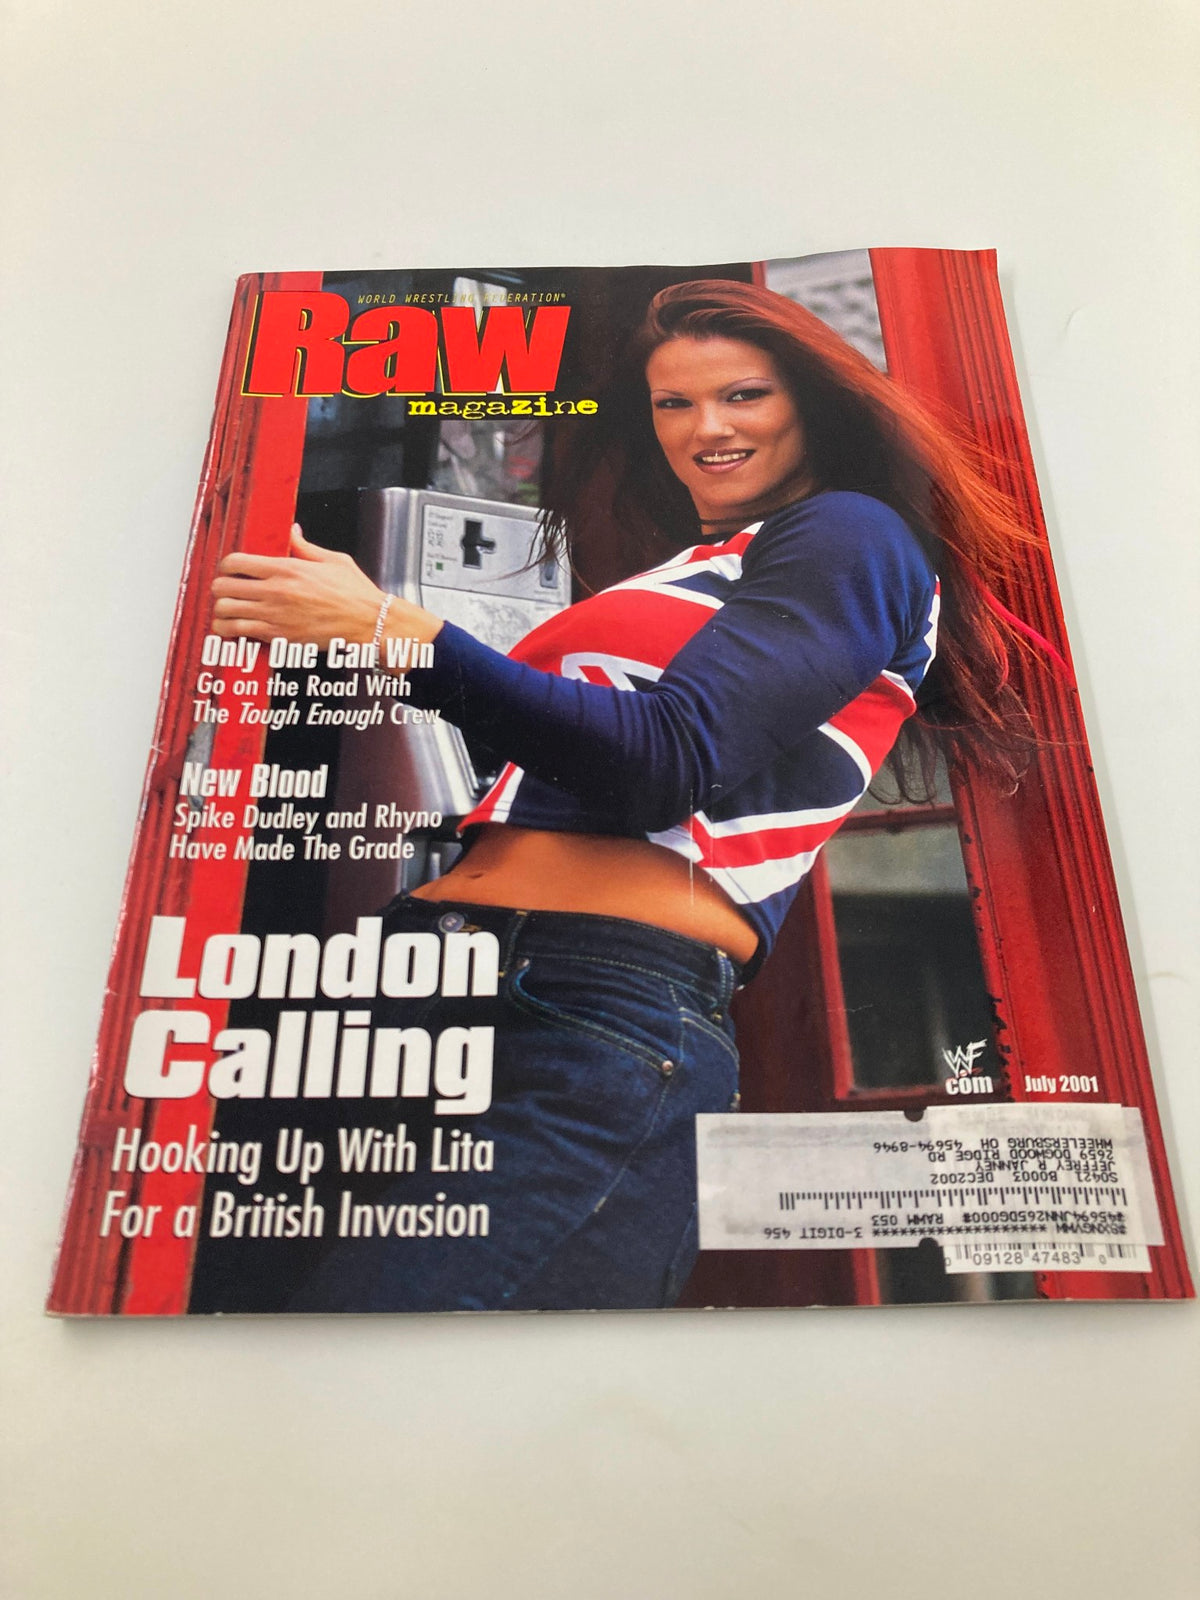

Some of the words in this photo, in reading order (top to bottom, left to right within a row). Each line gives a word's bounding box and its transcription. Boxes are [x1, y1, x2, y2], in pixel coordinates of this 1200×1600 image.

[357, 294, 396, 305] WORLD
[241, 290, 572, 398] Raw
[407, 398, 599, 420] magazine
[201, 634, 261, 673] Only
[268, 637, 319, 669] One
[326, 637, 377, 669] Can
[386, 637, 435, 669] Win
[196, 672, 225, 695] Go
[232, 678, 258, 696] on
[266, 674, 299, 697] the
[306, 675, 359, 697] Road
[366, 675, 411, 697] With
[193, 700, 230, 724] The
[239, 702, 300, 731] Tough
[306, 702, 384, 731] Enough
[390, 703, 441, 725] Crew
[179, 761, 242, 799] New
[250, 763, 329, 799] Blood
[173, 802, 235, 833] Spike
[243, 802, 319, 835] Dudley
[325, 802, 368, 829] and
[374, 802, 443, 833] Rhyno
[168, 834, 227, 860] Have
[233, 835, 295, 861] Made
[302, 834, 342, 861] The
[349, 833, 416, 860] Grade
[139, 915, 501, 1000] London
[123, 1009, 496, 1116] Calling
[1024, 1075, 1057, 1094] July
[1059, 1075, 1099, 1093] 2001
[872, 1140, 964, 1153] 45694-8946
[979, 1139, 1000, 1150] OH
[1008, 1138, 1114, 1150] WHEELERSBURG
[110, 1124, 263, 1186] Hooking
[275, 1128, 325, 1185] Up
[337, 1123, 418, 1173] With
[430, 1127, 495, 1173] Lita
[927, 1151, 947, 1162] RD
[954, 1150, 1001, 1161] RIDGE
[1009, 1149, 1072, 1160] DOGWOOD
[1078, 1149, 1115, 1160] 2659
[974, 1160, 1029, 1172] JANNEY
[1038, 1160, 1047, 1171] R
[1056, 1160, 1116, 1171] JEFFREY
[928, 1172, 994, 1185] DEC2002
[99, 1190, 163, 1238] For
[172, 1205, 197, 1237] a
[208, 1186, 326, 1239] British
[338, 1191, 491, 1238] Invasion
[906, 1213, 945, 1225] RAWM
[870, 1214, 899, 1226] 053
[763, 1227, 791, 1239] 456
[799, 1227, 863, 1239] 3-DIGIT
[972, 1252, 1024, 1266] 09128
[1031, 1251, 1082, 1264] 47483
